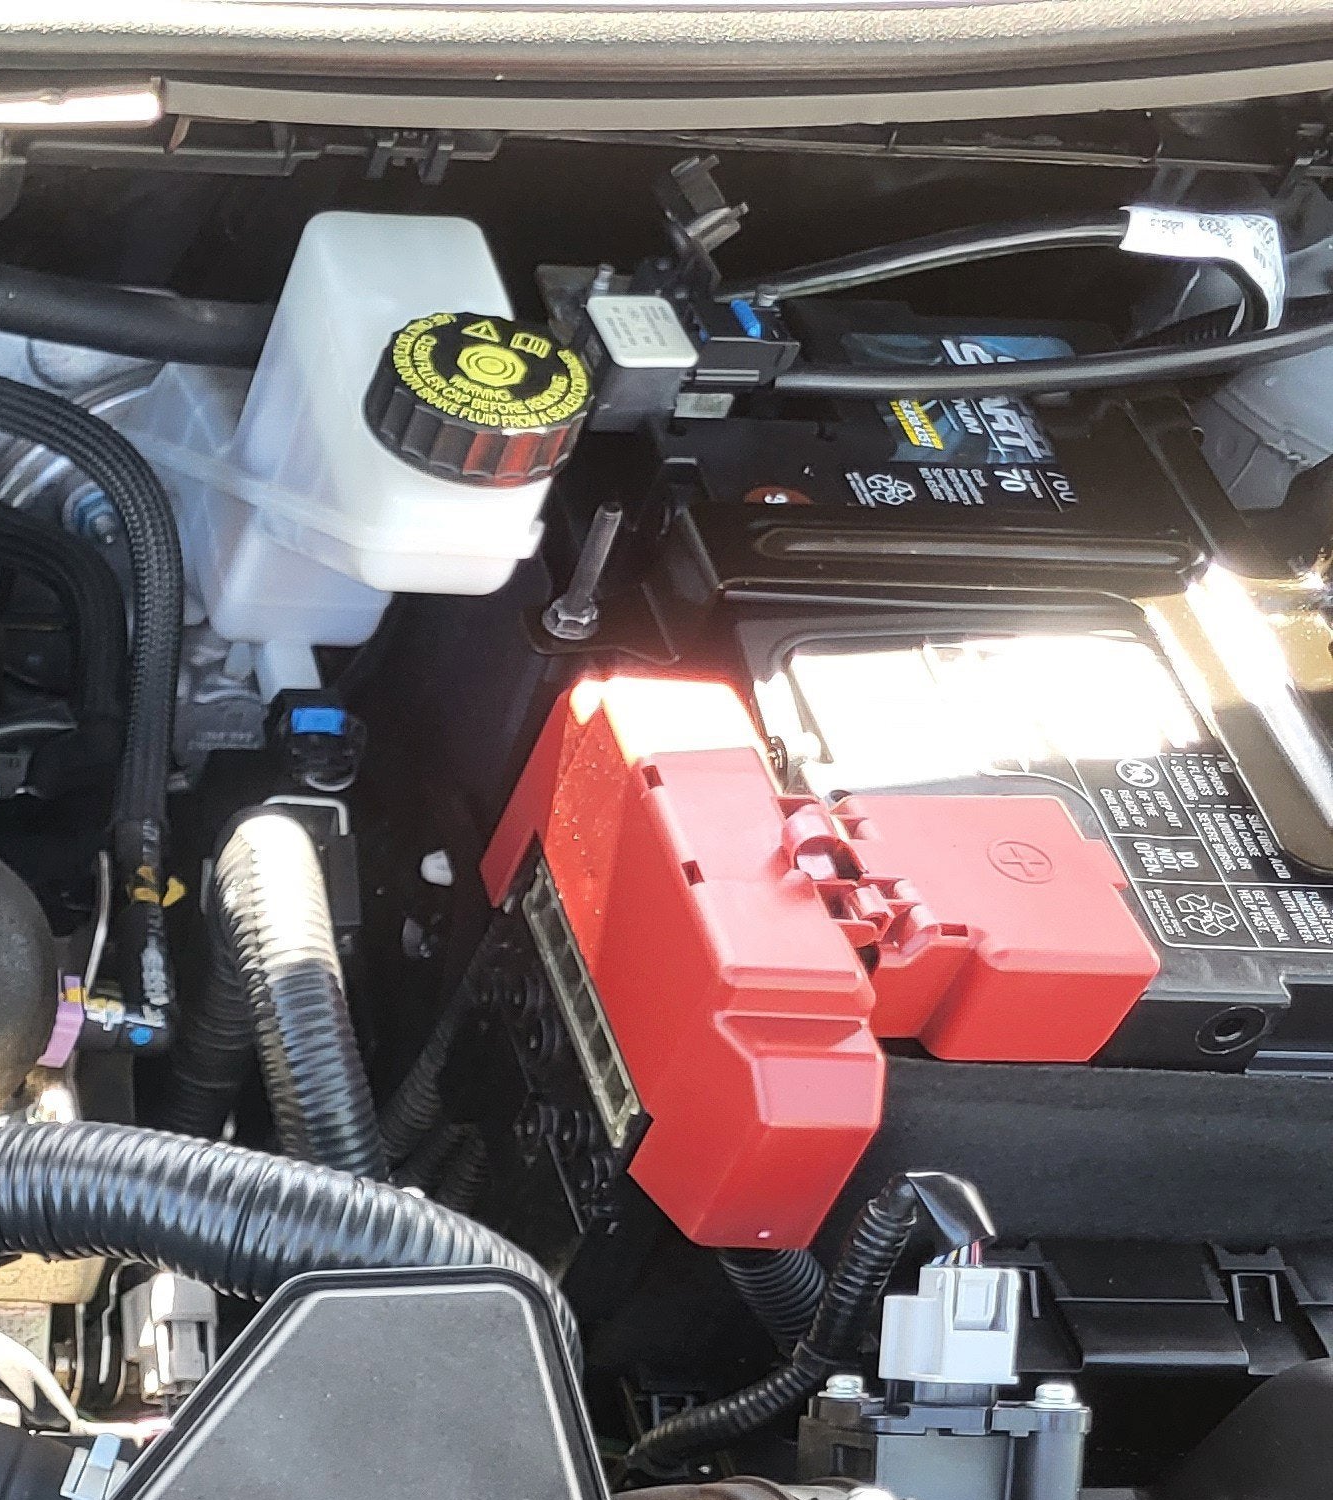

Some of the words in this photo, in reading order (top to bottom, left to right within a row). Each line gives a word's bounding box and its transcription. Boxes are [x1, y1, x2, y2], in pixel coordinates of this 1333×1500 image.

[442, 387, 471, 406] CAP
[471, 397, 531, 413] BEFORE
[458, 407, 500, 427] FLUID
[501, 415, 541, 428] FROM
[991, 468, 1028, 491] 70
[1186, 766, 1213, 795] FLAMES
[1117, 789, 1140, 814] REACH
[1130, 816, 1148, 827] OF
[1134, 790, 1151, 801] OF
[1140, 801, 1159, 816] THE
[1152, 790, 1174, 810] KEEP
[1163, 811, 1184, 827] OUT
[1194, 812, 1221, 841] SEVERE
[1227, 813, 1246, 829] CAN
[1211, 812, 1246, 856] BLINDNESS
[1235, 858, 1253, 869] OR
[1236, 831, 1262, 857] CAUSE
[1244, 813, 1278, 855] SULFURIC
[1267, 858, 1291, 878] ACID
[1131, 842, 1166, 877] OPEN.
[1153, 847, 1181, 871] NOT
[1174, 851, 1200, 867] DO
[1235, 889, 1258, 910] HELP
[1248, 912, 1271, 933] FAST.
[1250, 890, 1272, 907] GET
[1306, 892, 1331, 918] FLUSH
[1260, 908, 1291, 942] MEDICAL
[1277, 891, 1299, 911] WITH
[1289, 913, 1315, 944] WATER.
[1292, 891, 1331, 944] IMMEDIATELY
